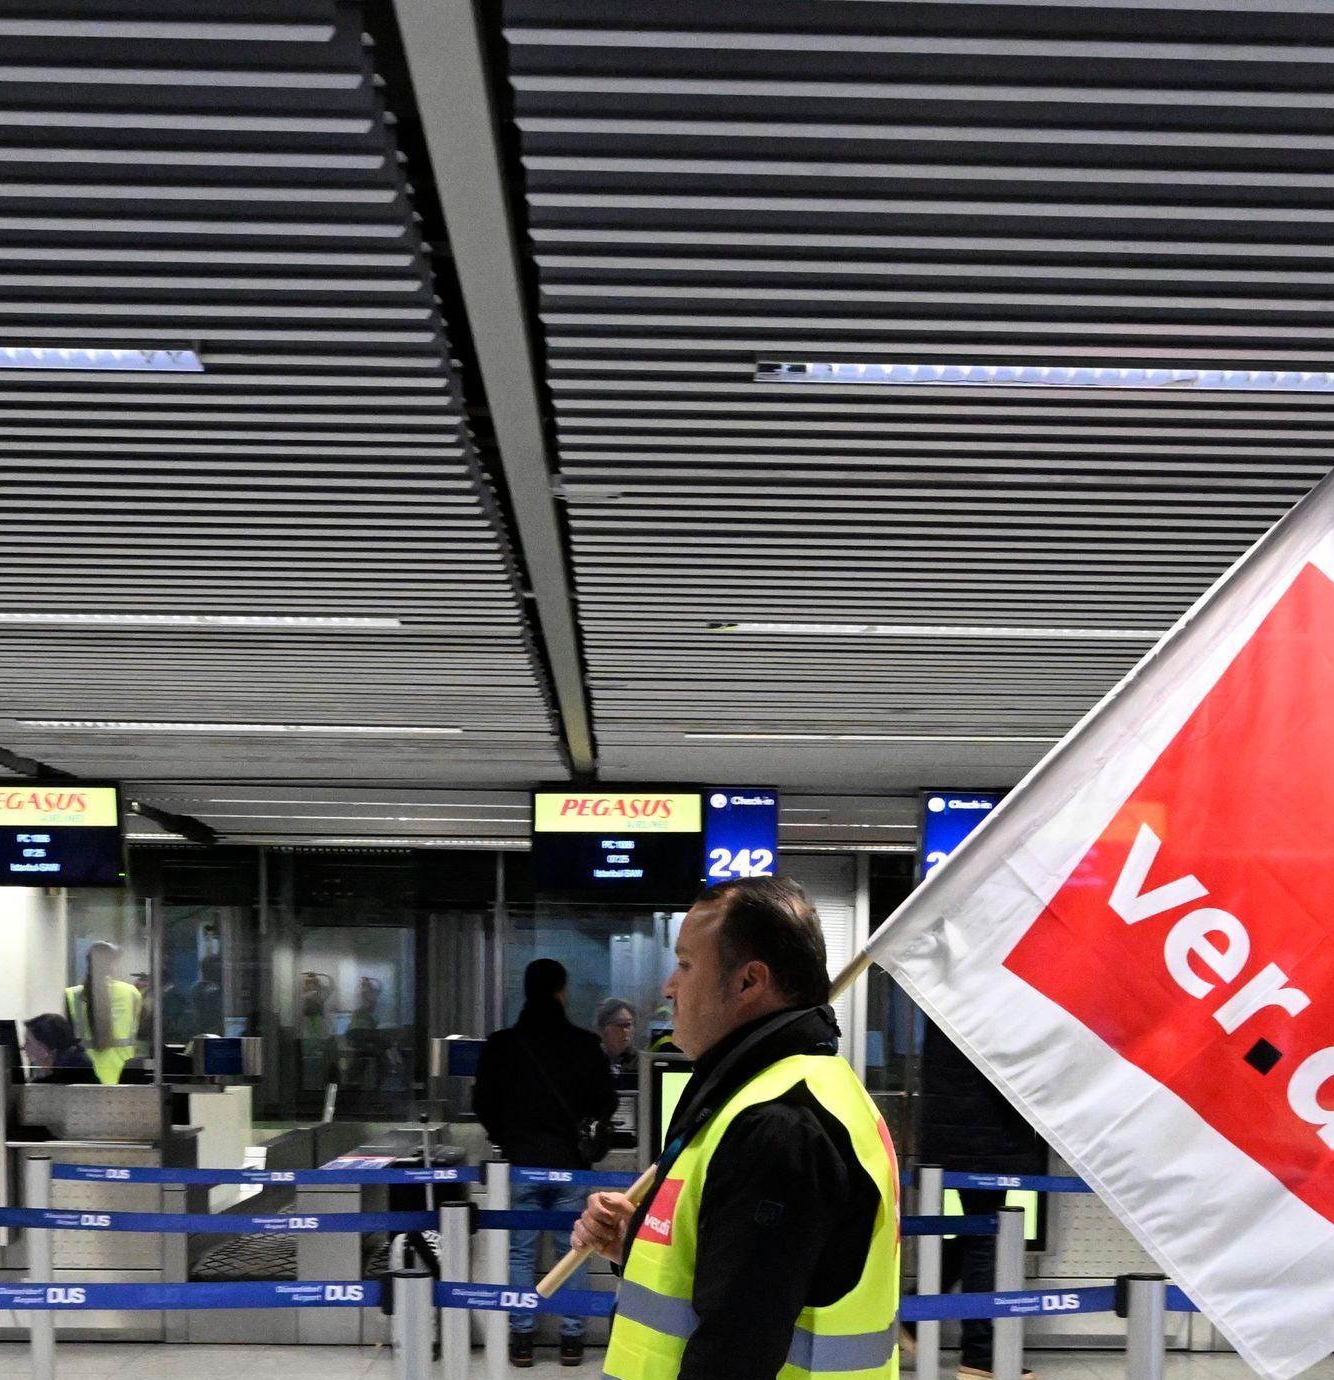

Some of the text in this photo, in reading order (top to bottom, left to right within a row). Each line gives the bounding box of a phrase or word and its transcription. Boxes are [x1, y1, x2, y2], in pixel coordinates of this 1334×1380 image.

[559, 799, 674, 818] PEGASUS
[709, 849, 773, 877] 242
[106, 1168, 131, 1179] DUS
[271, 1172, 295, 1182] DUS
[434, 1170, 458, 1180] DUS
[549, 1171, 573, 1182] DUS
[997, 1177, 1021, 1188] DUS
[80, 1215, 110, 1227] DUS
[289, 1217, 318, 1229] DUS
[47, 1287, 86, 1304] DUS
[325, 1284, 364, 1302] DUS
[500, 1291, 539, 1309] DUS
[1042, 1293, 1081, 1311] DUS
